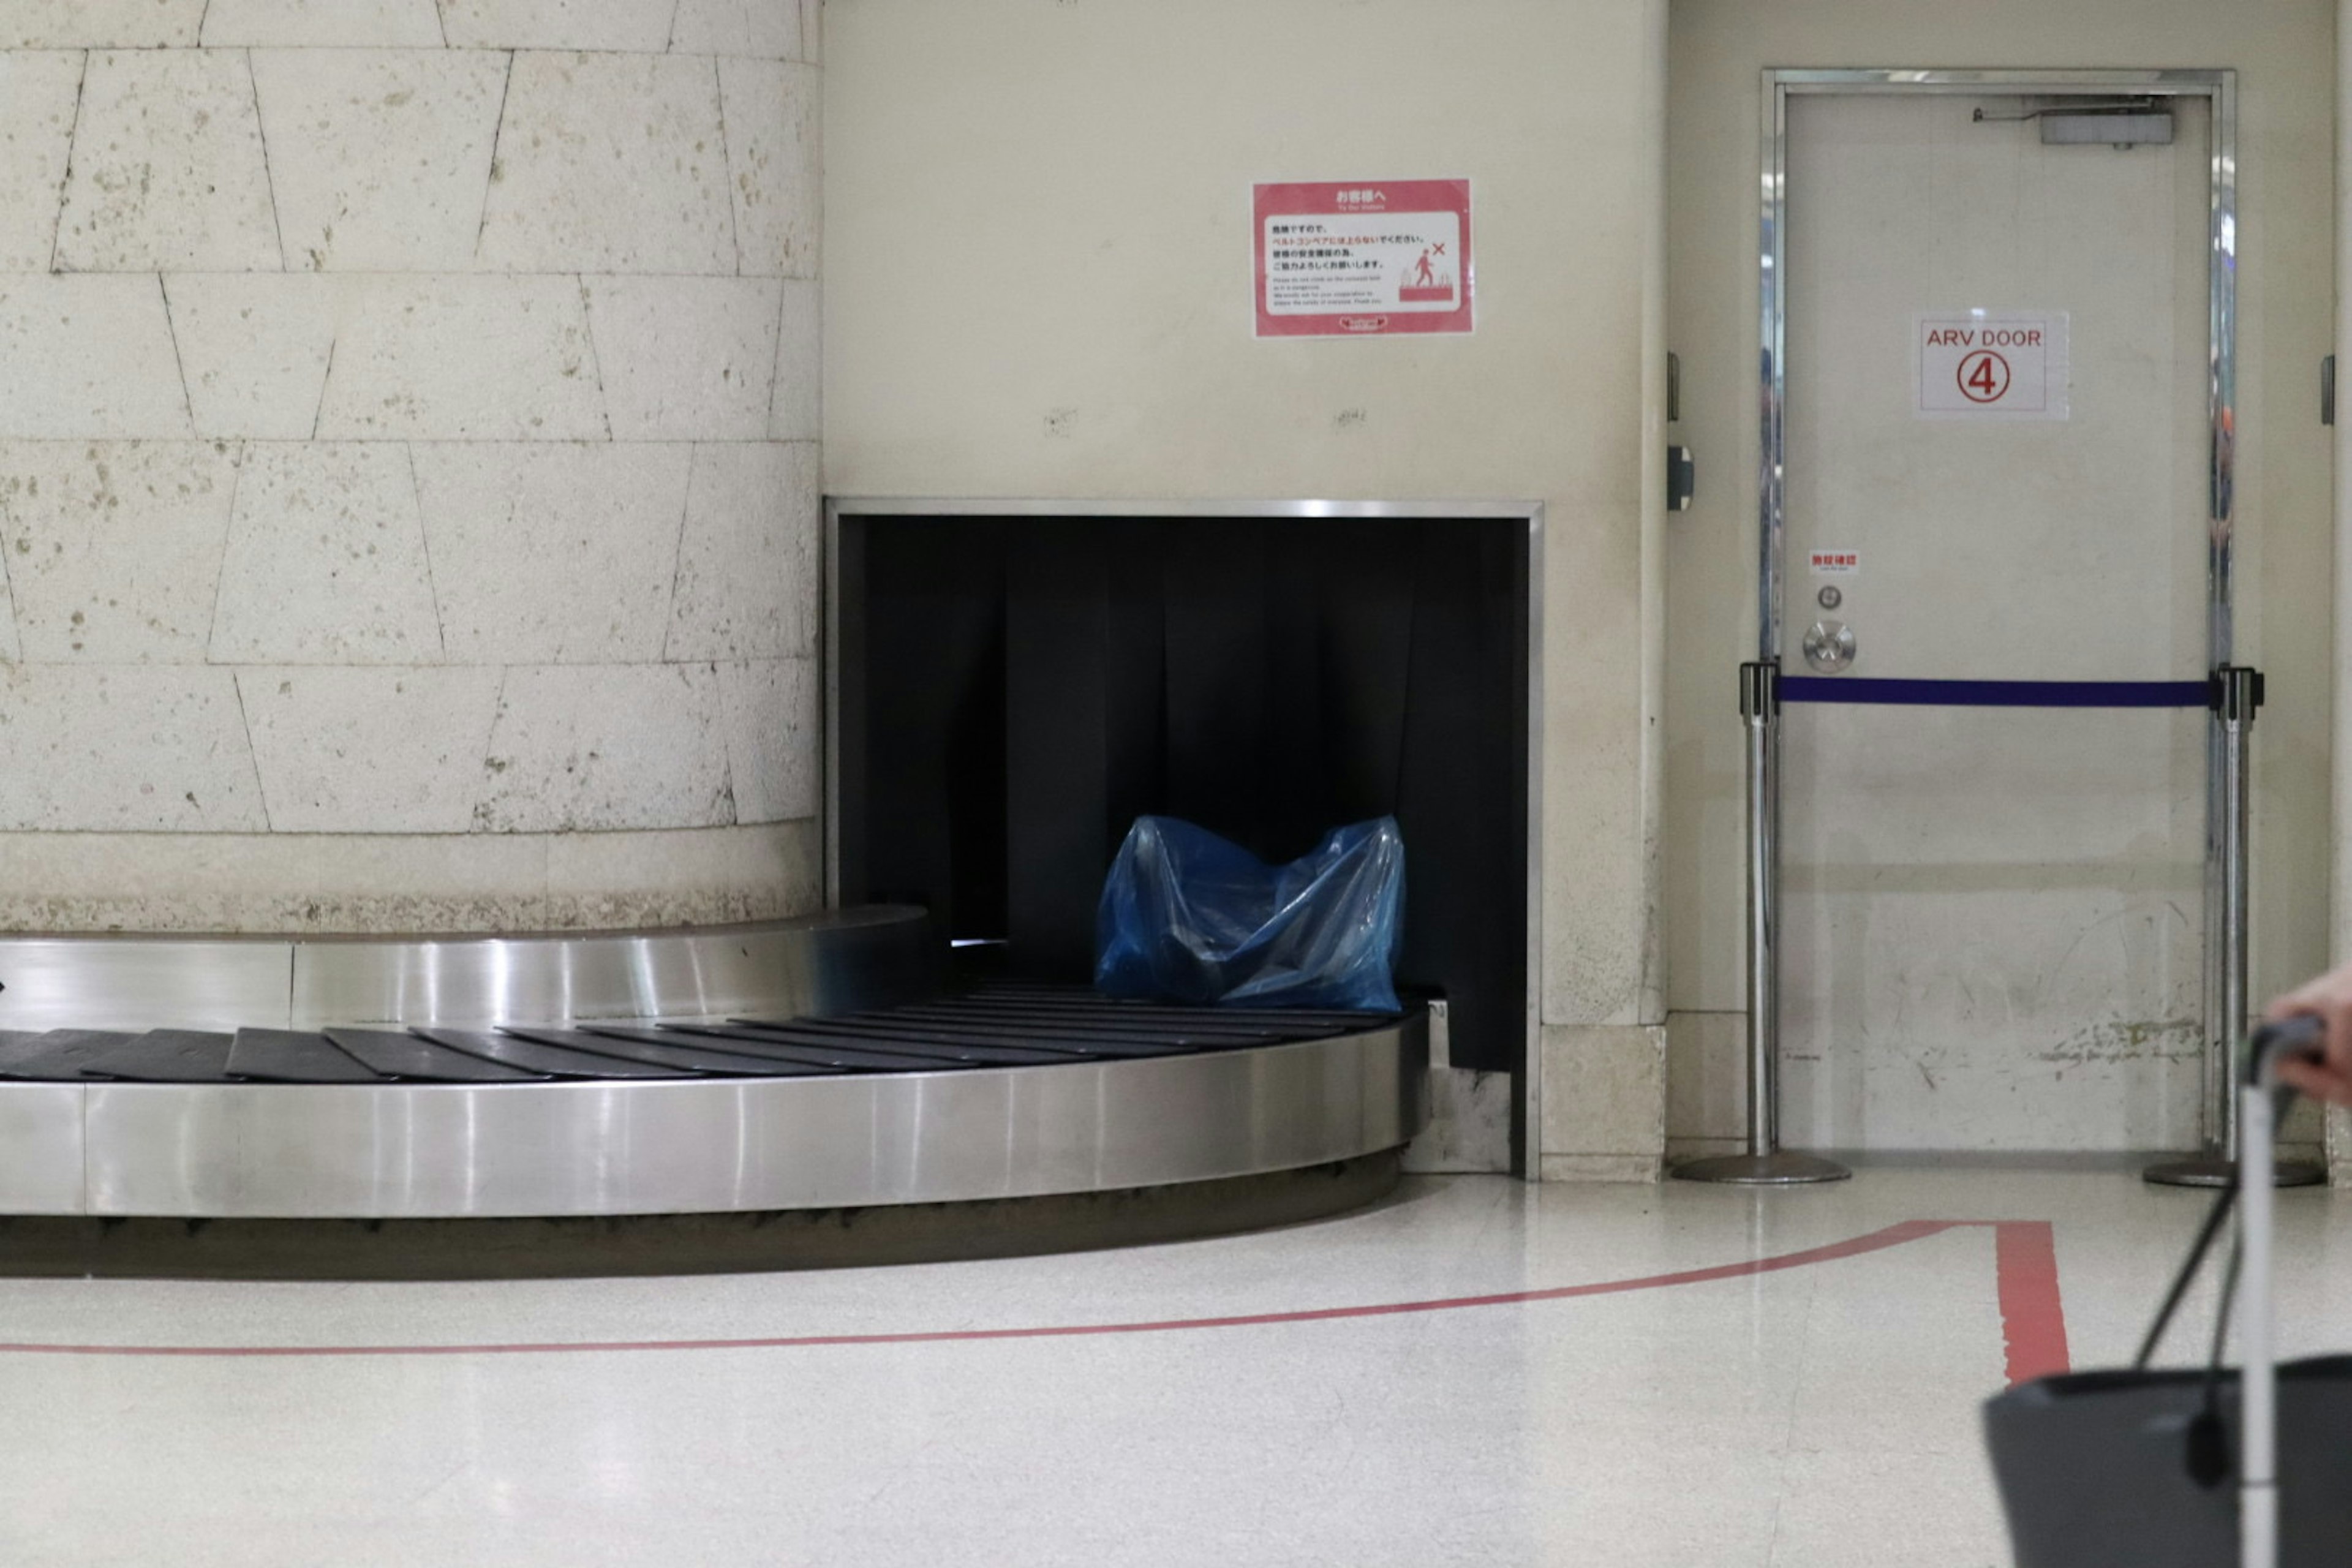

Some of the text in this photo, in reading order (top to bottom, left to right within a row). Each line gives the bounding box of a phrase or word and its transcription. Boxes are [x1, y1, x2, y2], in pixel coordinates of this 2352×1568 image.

[1336, 190, 1386, 203] お客様へ
[1273, 225, 1327, 234] 危険ですので、
[1273, 260, 1383, 271] ご協力よろしくお願いします。
[1927, 330, 2041, 347] ARV DOOR
[1969, 357, 1996, 395] 4
